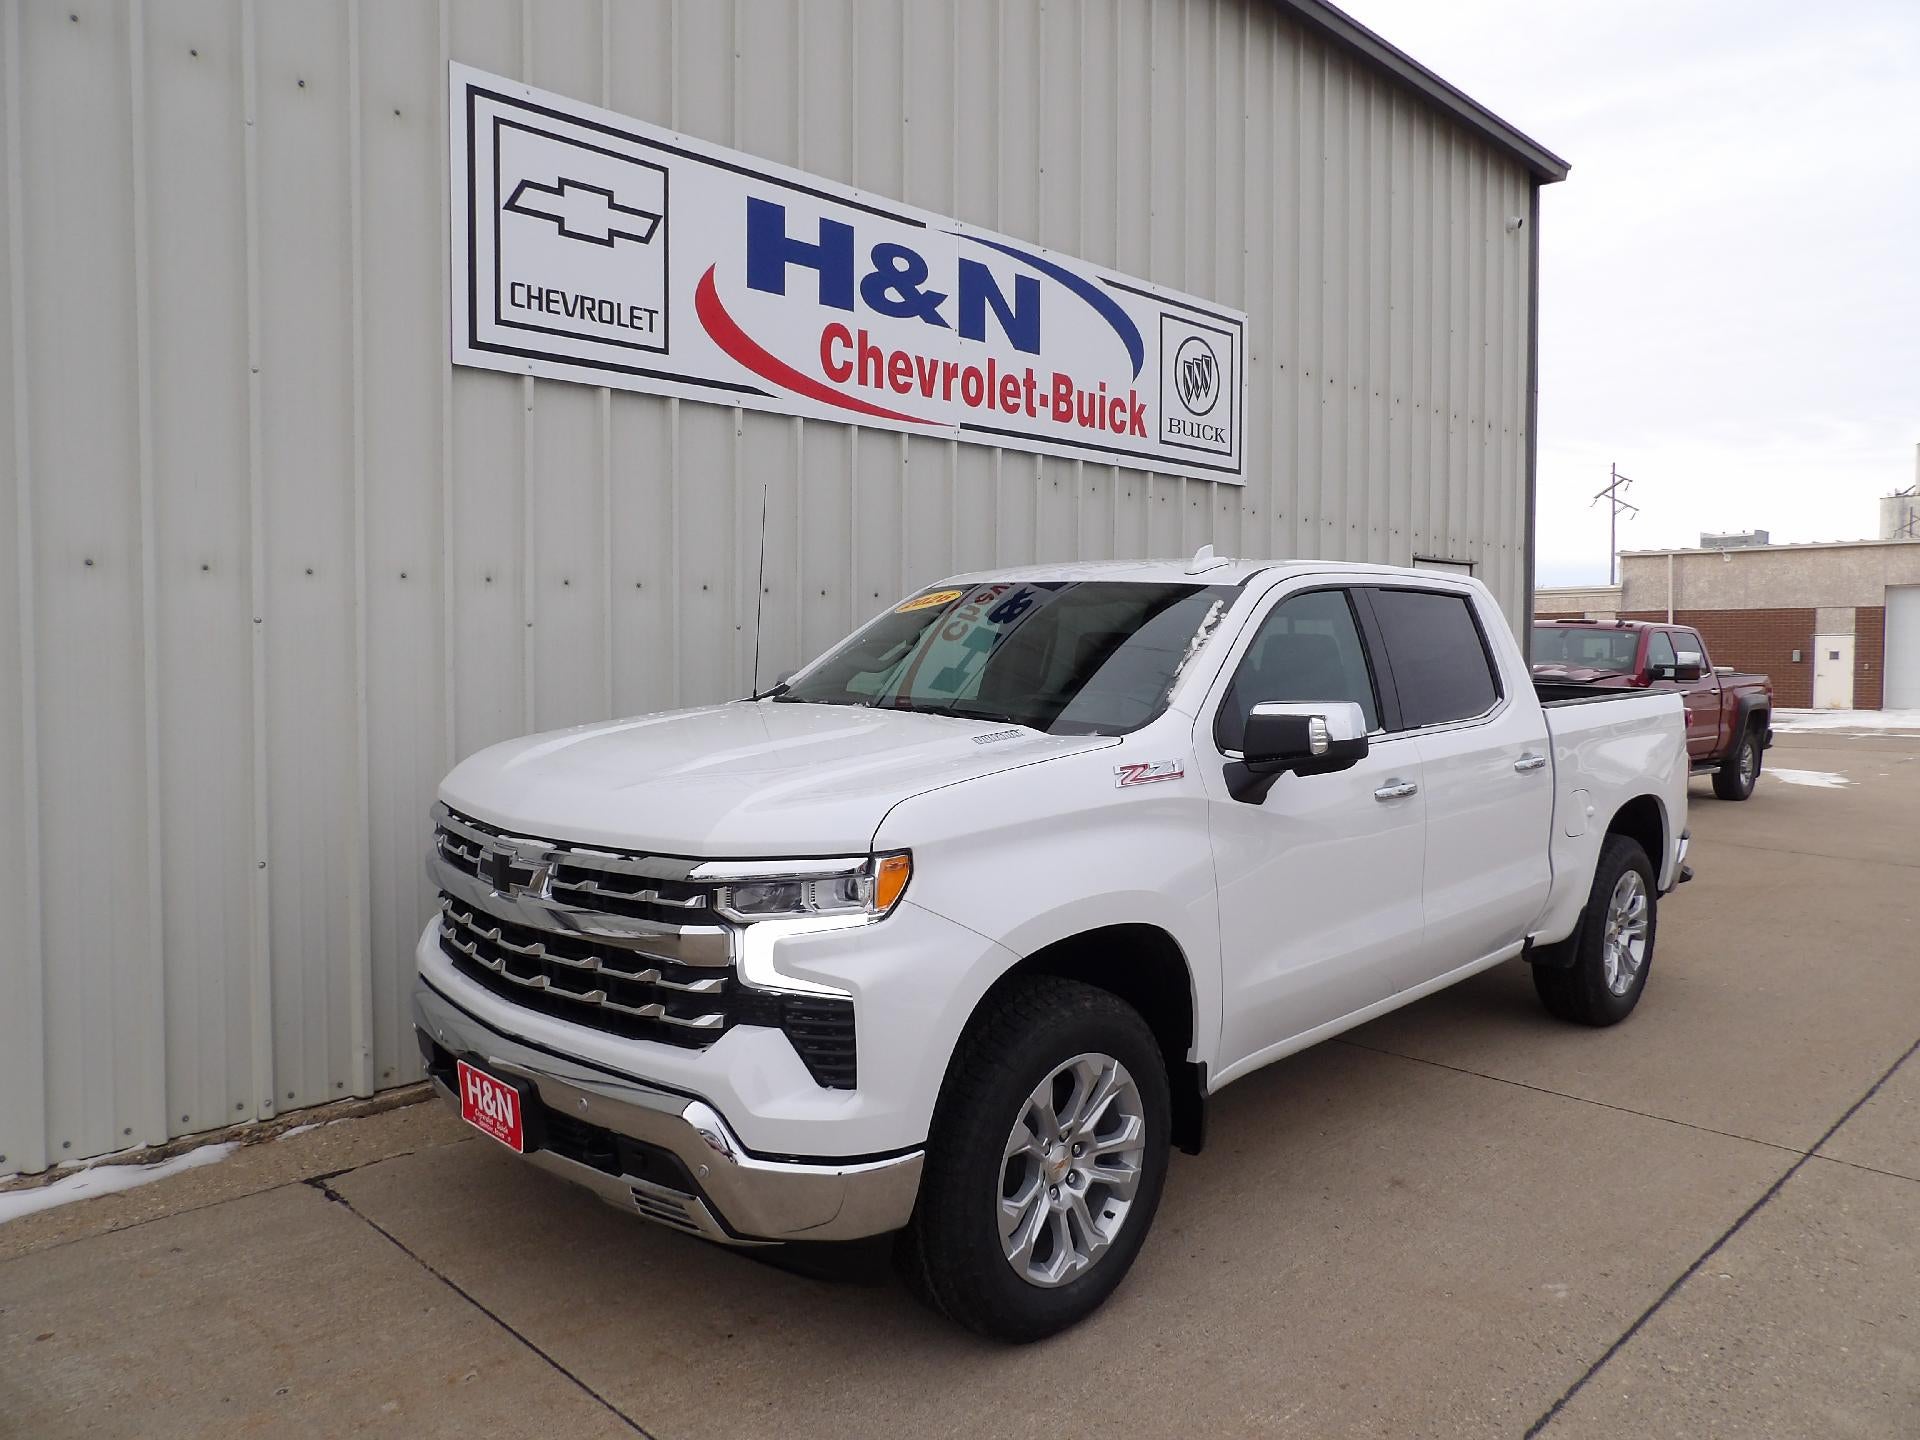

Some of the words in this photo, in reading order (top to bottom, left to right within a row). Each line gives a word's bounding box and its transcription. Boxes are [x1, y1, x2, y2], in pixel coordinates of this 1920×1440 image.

[747, 196, 1041, 355] H&N
[510, 281, 659, 333] CHEVROLET
[820, 322, 1148, 438] Chevrolet-Buick
[1167, 417, 1226, 444] BUICK
[1114, 759, 1184, 788] Z71
[466, 1071, 514, 1129] H&N
